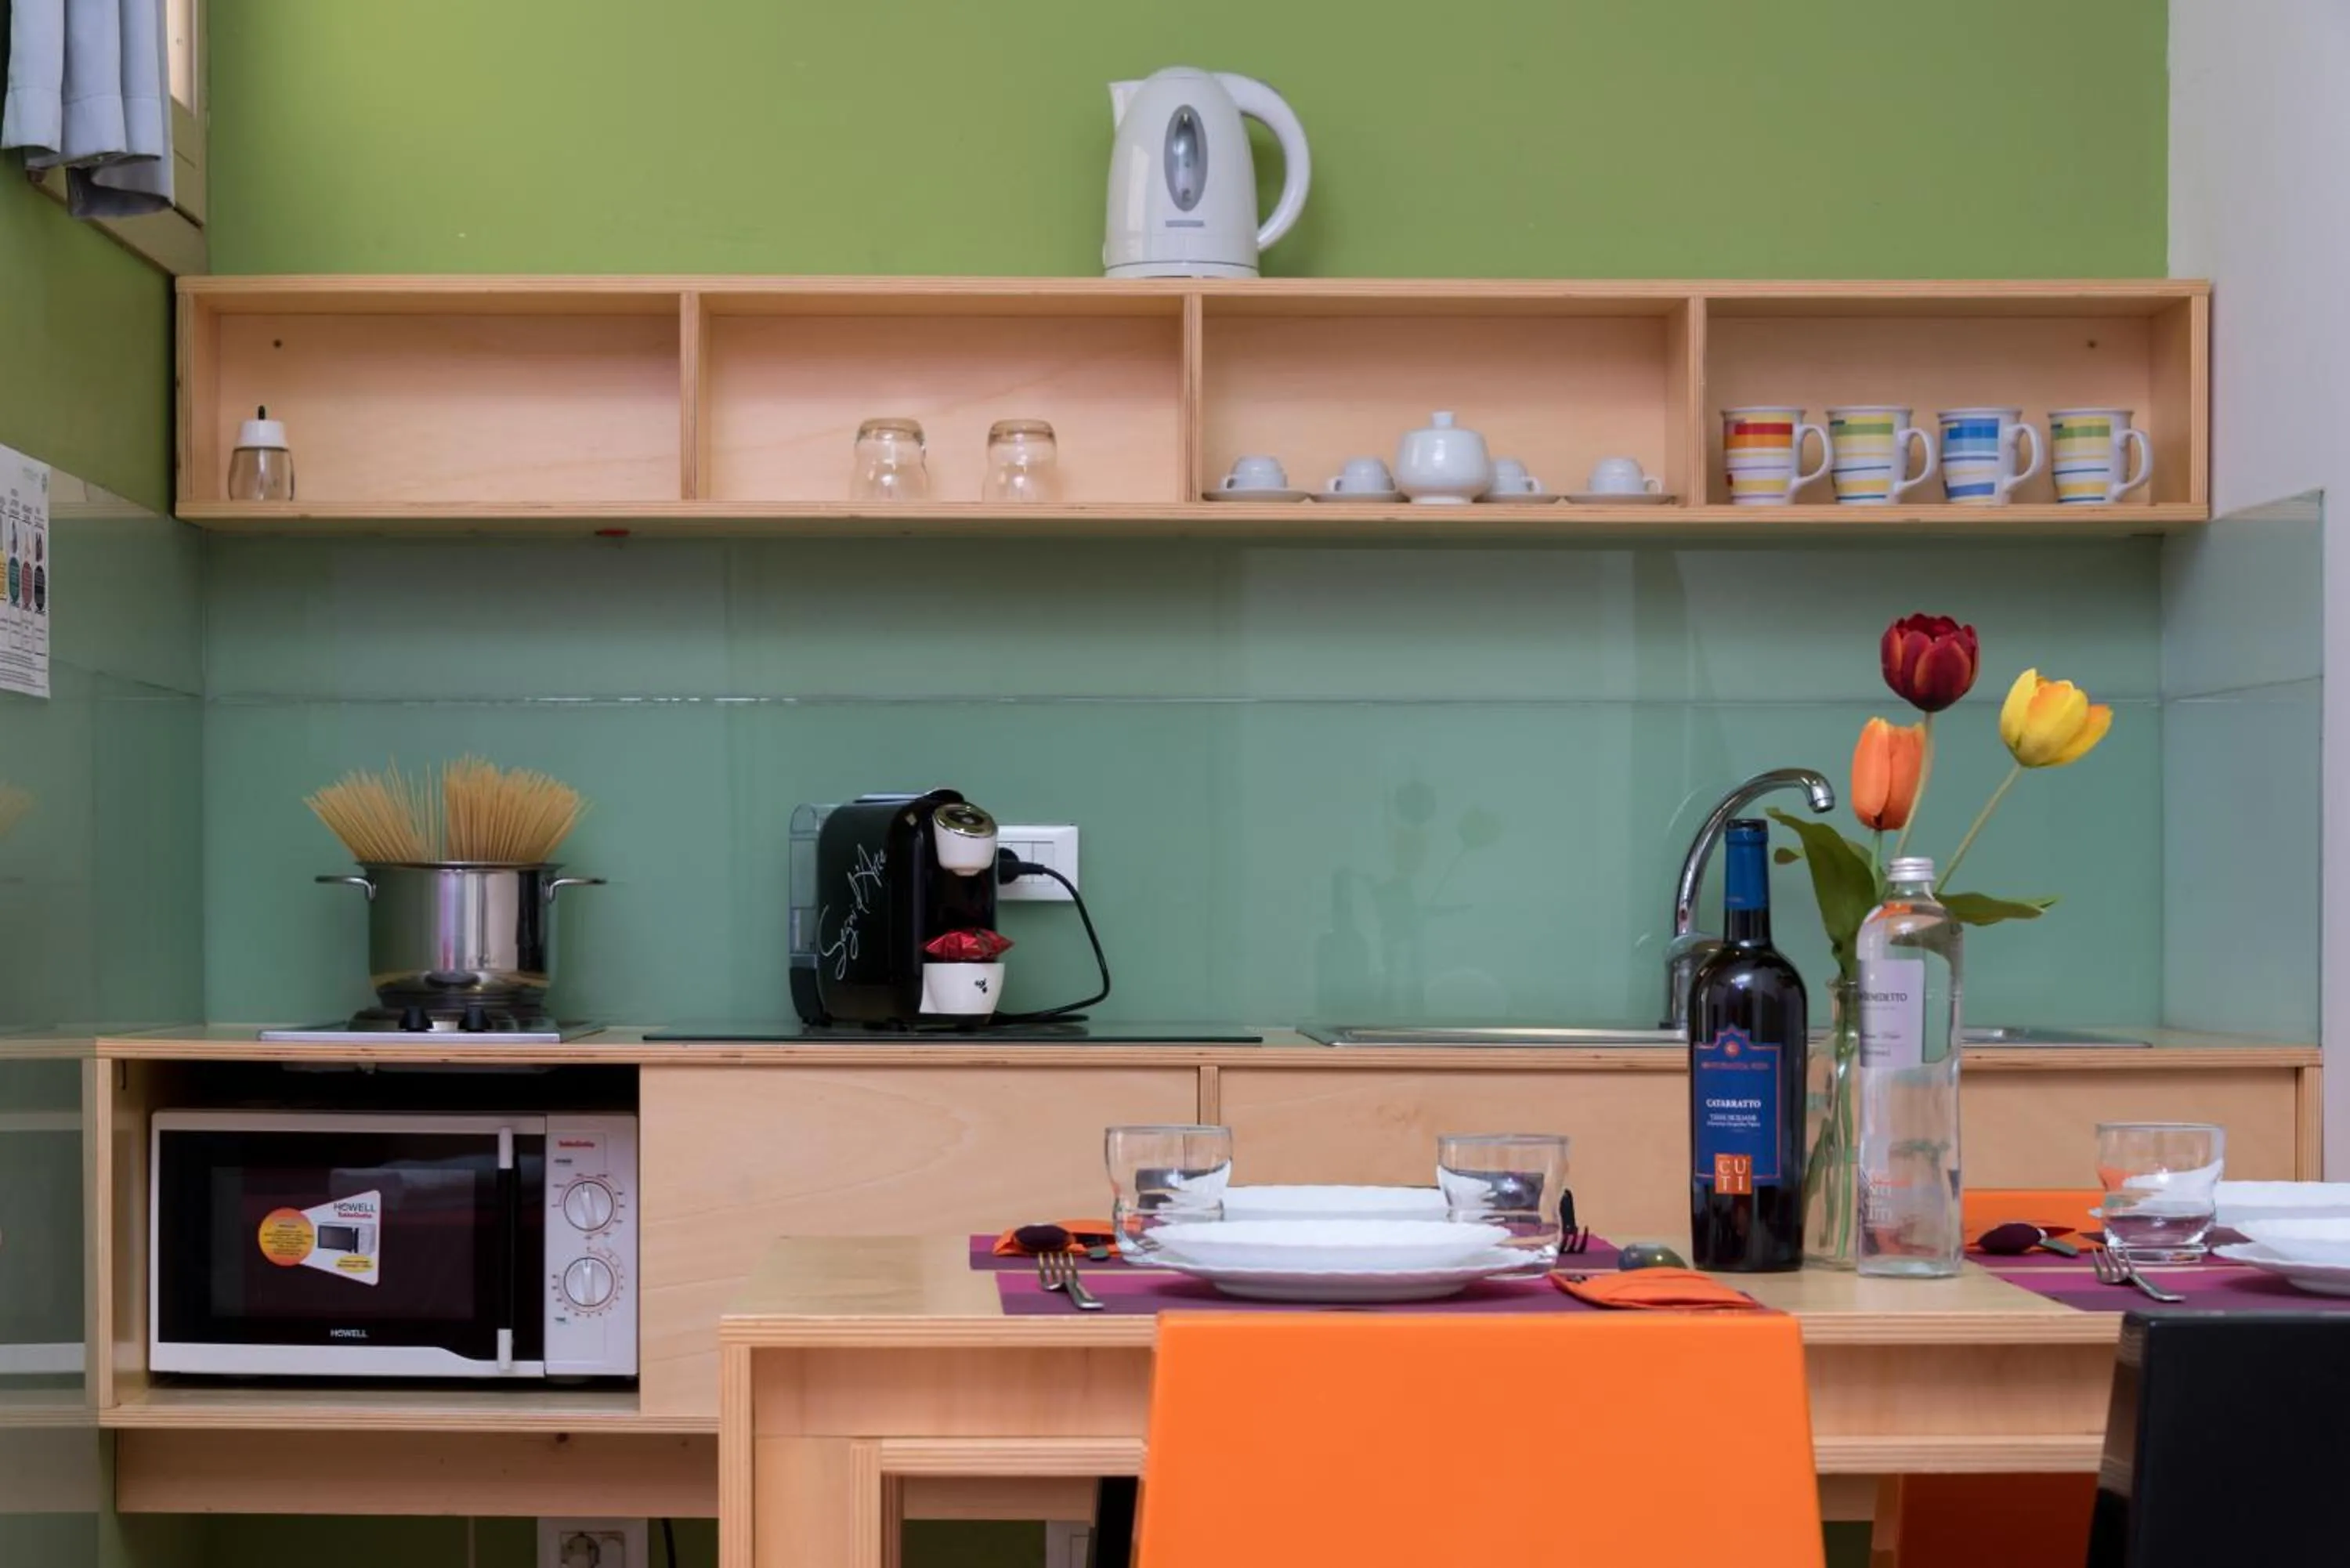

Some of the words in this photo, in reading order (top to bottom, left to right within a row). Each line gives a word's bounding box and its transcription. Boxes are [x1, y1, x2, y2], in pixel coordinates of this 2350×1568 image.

[1705, 1098, 1762, 1109] CATARRATTO
[333, 1202, 376, 1212] HOWELL
[330, 1328, 370, 1339] HOWELL
